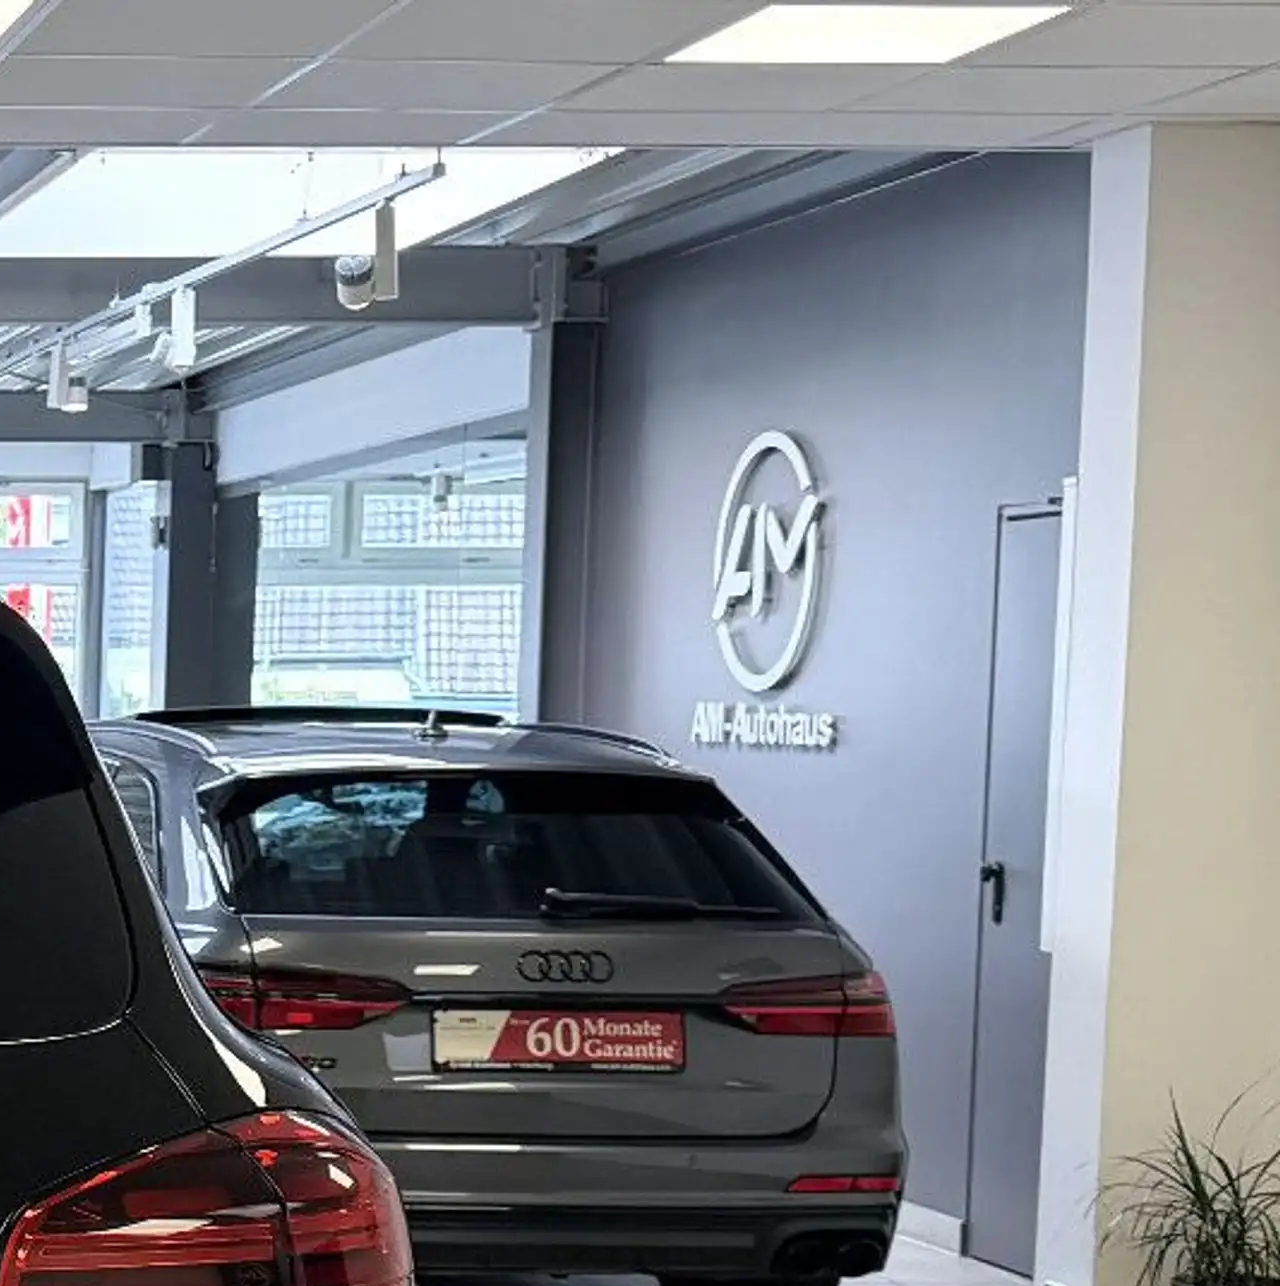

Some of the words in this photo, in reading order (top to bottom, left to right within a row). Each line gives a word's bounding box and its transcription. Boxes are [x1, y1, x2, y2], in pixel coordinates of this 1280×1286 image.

[692, 701, 834, 746] AM-Autohaus
[526, 1017, 580, 1057] 60
[584, 1018, 663, 1037] Monate
